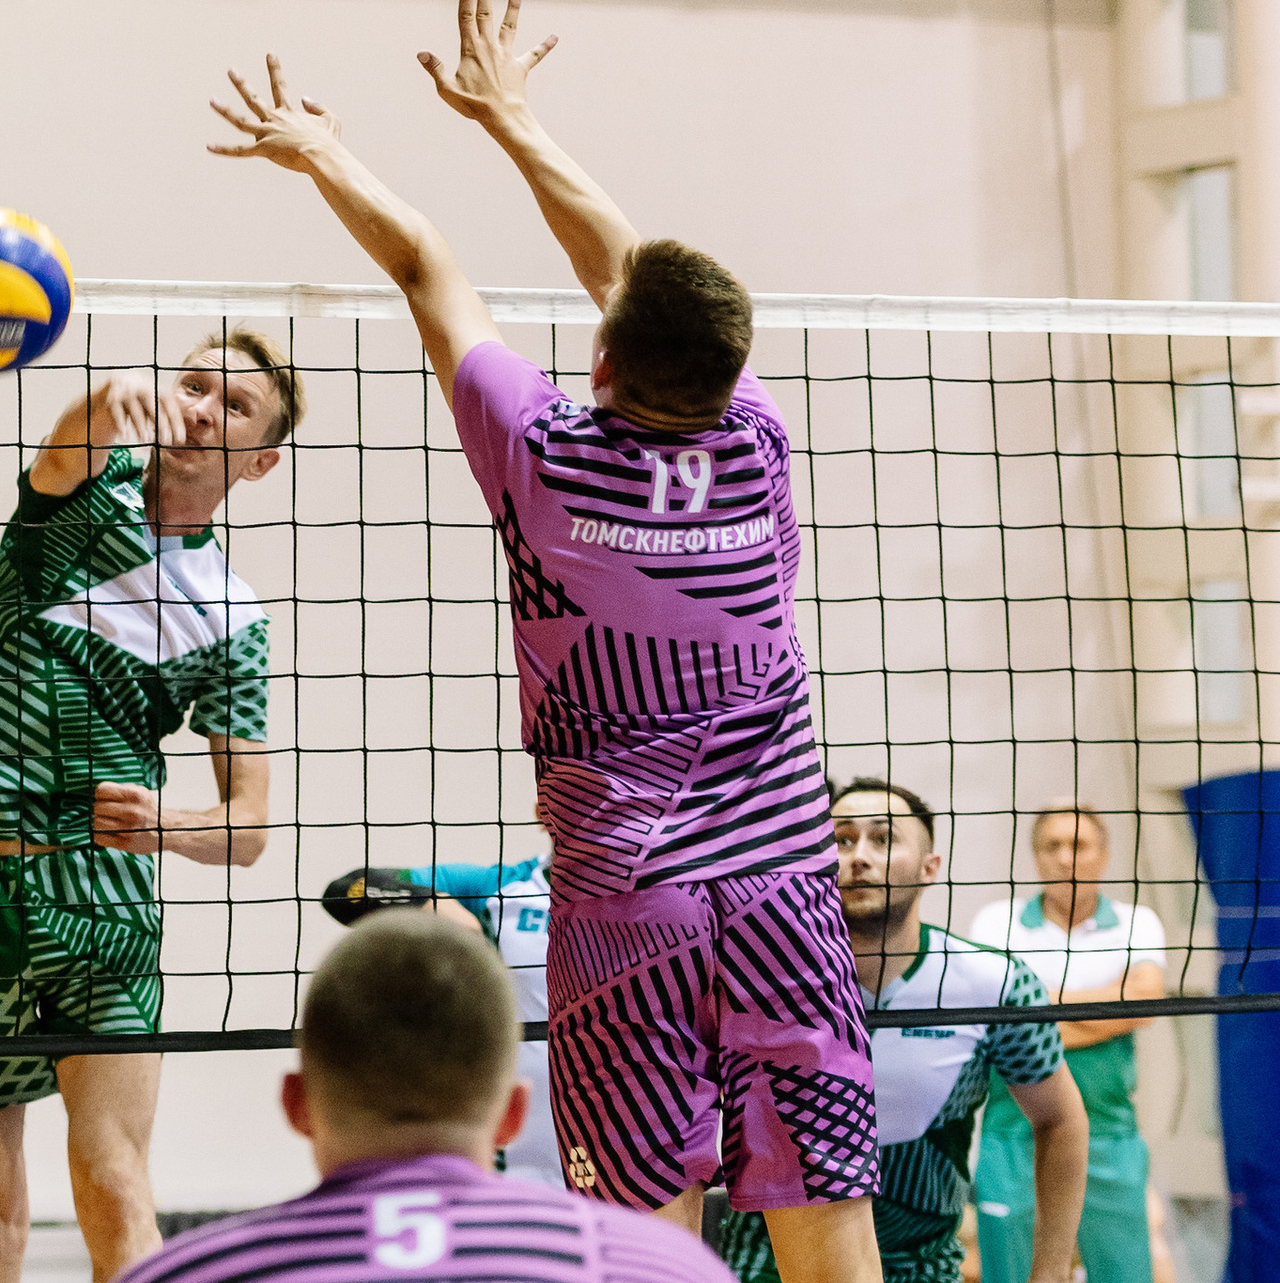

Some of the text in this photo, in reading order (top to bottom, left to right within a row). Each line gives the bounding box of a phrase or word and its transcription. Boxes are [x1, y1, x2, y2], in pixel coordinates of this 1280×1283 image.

[643, 449, 712, 514] 19
[570, 515, 774, 554] ТОМСКНЕФТЕХИМ
[373, 1191, 446, 1270] 5
